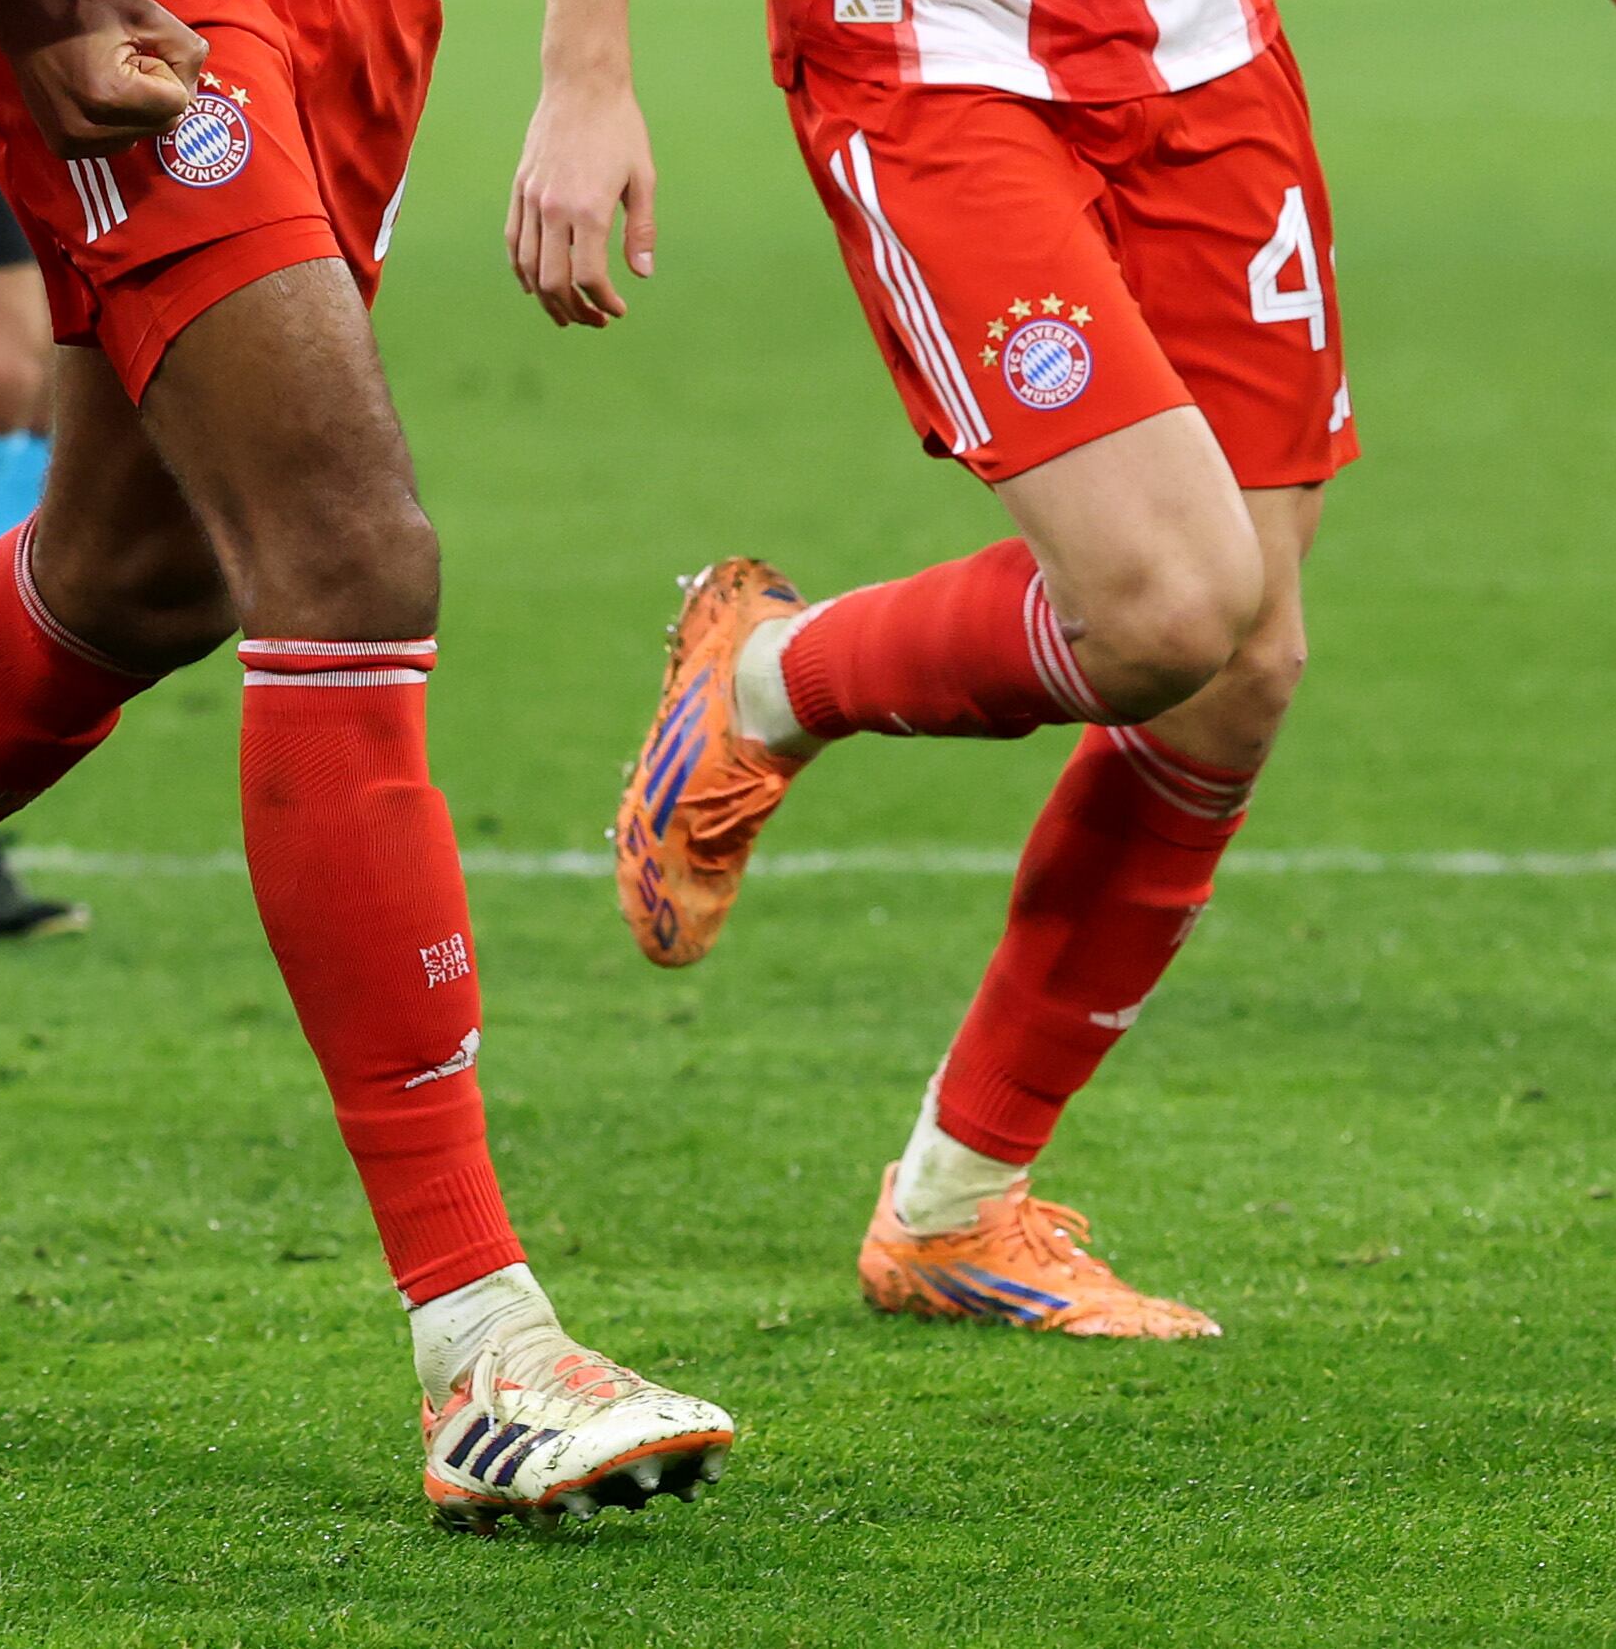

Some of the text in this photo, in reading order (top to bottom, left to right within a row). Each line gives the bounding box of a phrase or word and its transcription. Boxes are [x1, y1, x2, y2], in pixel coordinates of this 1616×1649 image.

[1247, 185, 1336, 351] 4
[1015, 326, 1077, 350] BAYERN
[419, 933, 463, 962] MIA
[425, 945, 466, 973] SAN
[428, 961, 470, 989] MIA
